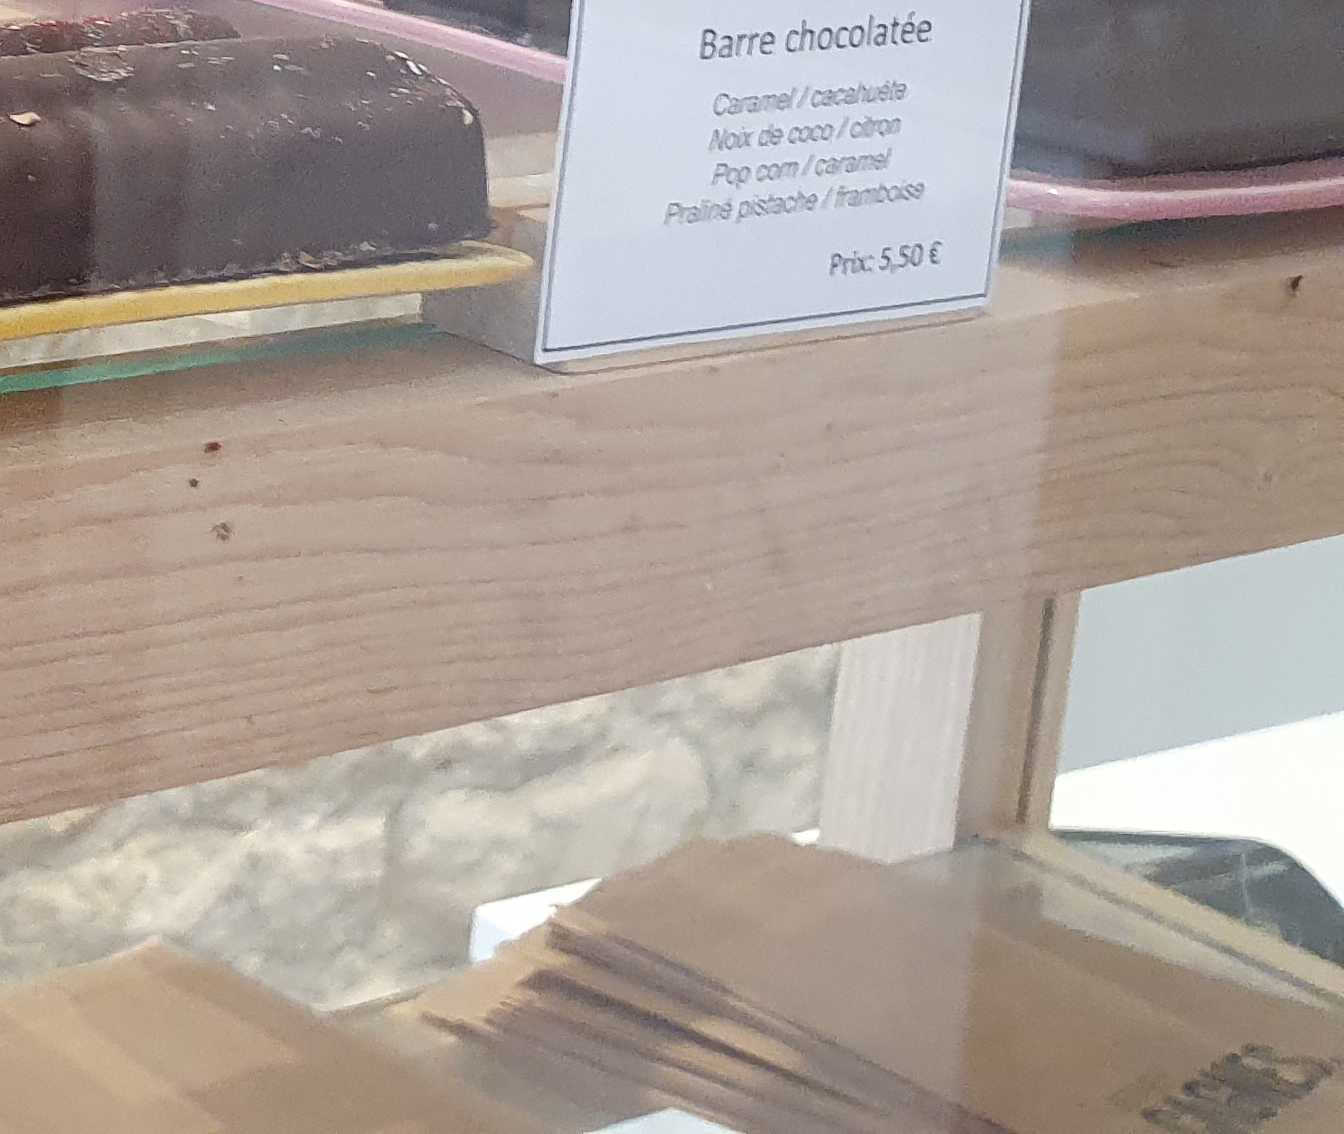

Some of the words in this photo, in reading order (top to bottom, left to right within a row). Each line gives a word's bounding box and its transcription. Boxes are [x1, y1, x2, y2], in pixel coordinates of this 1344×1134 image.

[700, 28, 775, 60] Barre
[785, 10, 932, 53] chocolatée
[713, 86, 797, 116] Caramel
[709, 128, 754, 152] Noix
[757, 124, 784, 147] de
[787, 122, 835, 145] coco
[850, 115, 902, 139] citron
[711, 163, 752, 188] Pop
[815, 147, 892, 177] caramel
[664, 199, 733, 225] Praliné
[736, 190, 819, 223] pistache
[834, 181, 926, 209] framboise
[878, 242, 924, 274] 5,50
[929, 240, 944, 265] €
